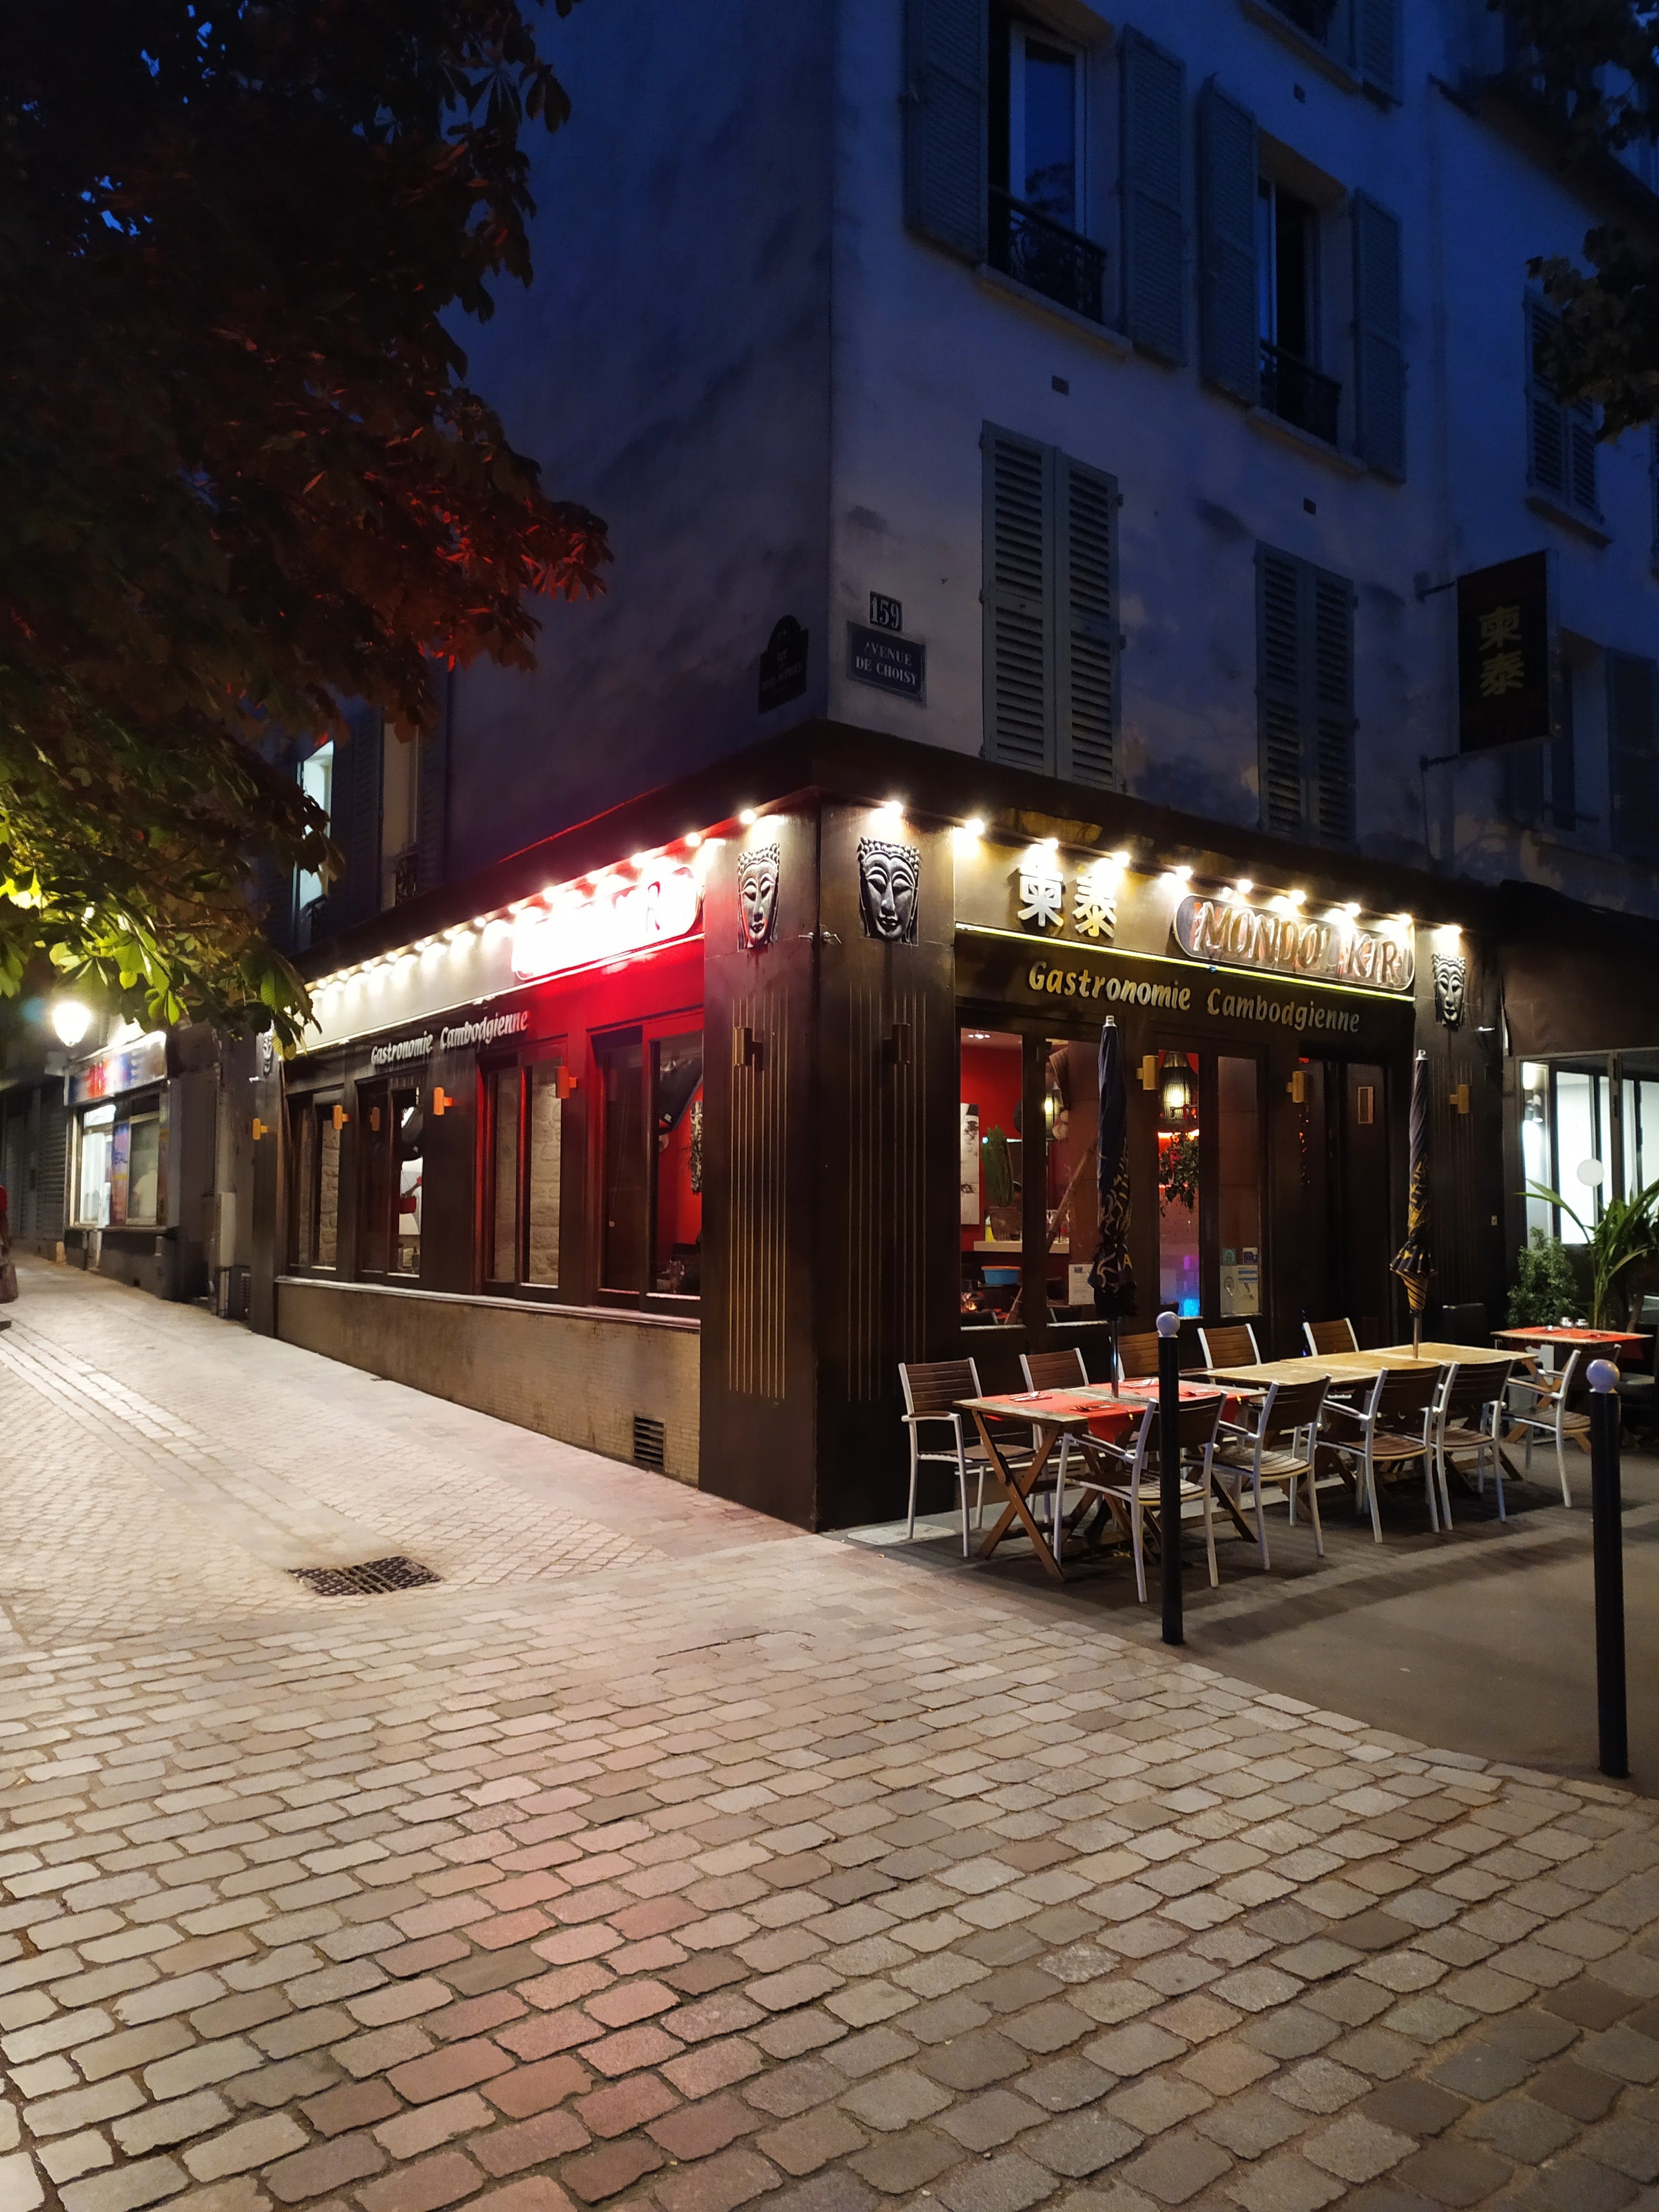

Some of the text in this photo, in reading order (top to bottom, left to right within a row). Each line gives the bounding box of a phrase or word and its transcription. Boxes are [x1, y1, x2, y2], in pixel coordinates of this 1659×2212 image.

[871, 596, 900, 629] 159
[863, 641, 912, 666] AVENUE
[855, 655, 917, 686] DE CHOISY
[1029, 961, 1360, 1032] Gastronomie Cambodgienne
[371, 1011, 530, 1066] Gastronomie Cambodgienne
